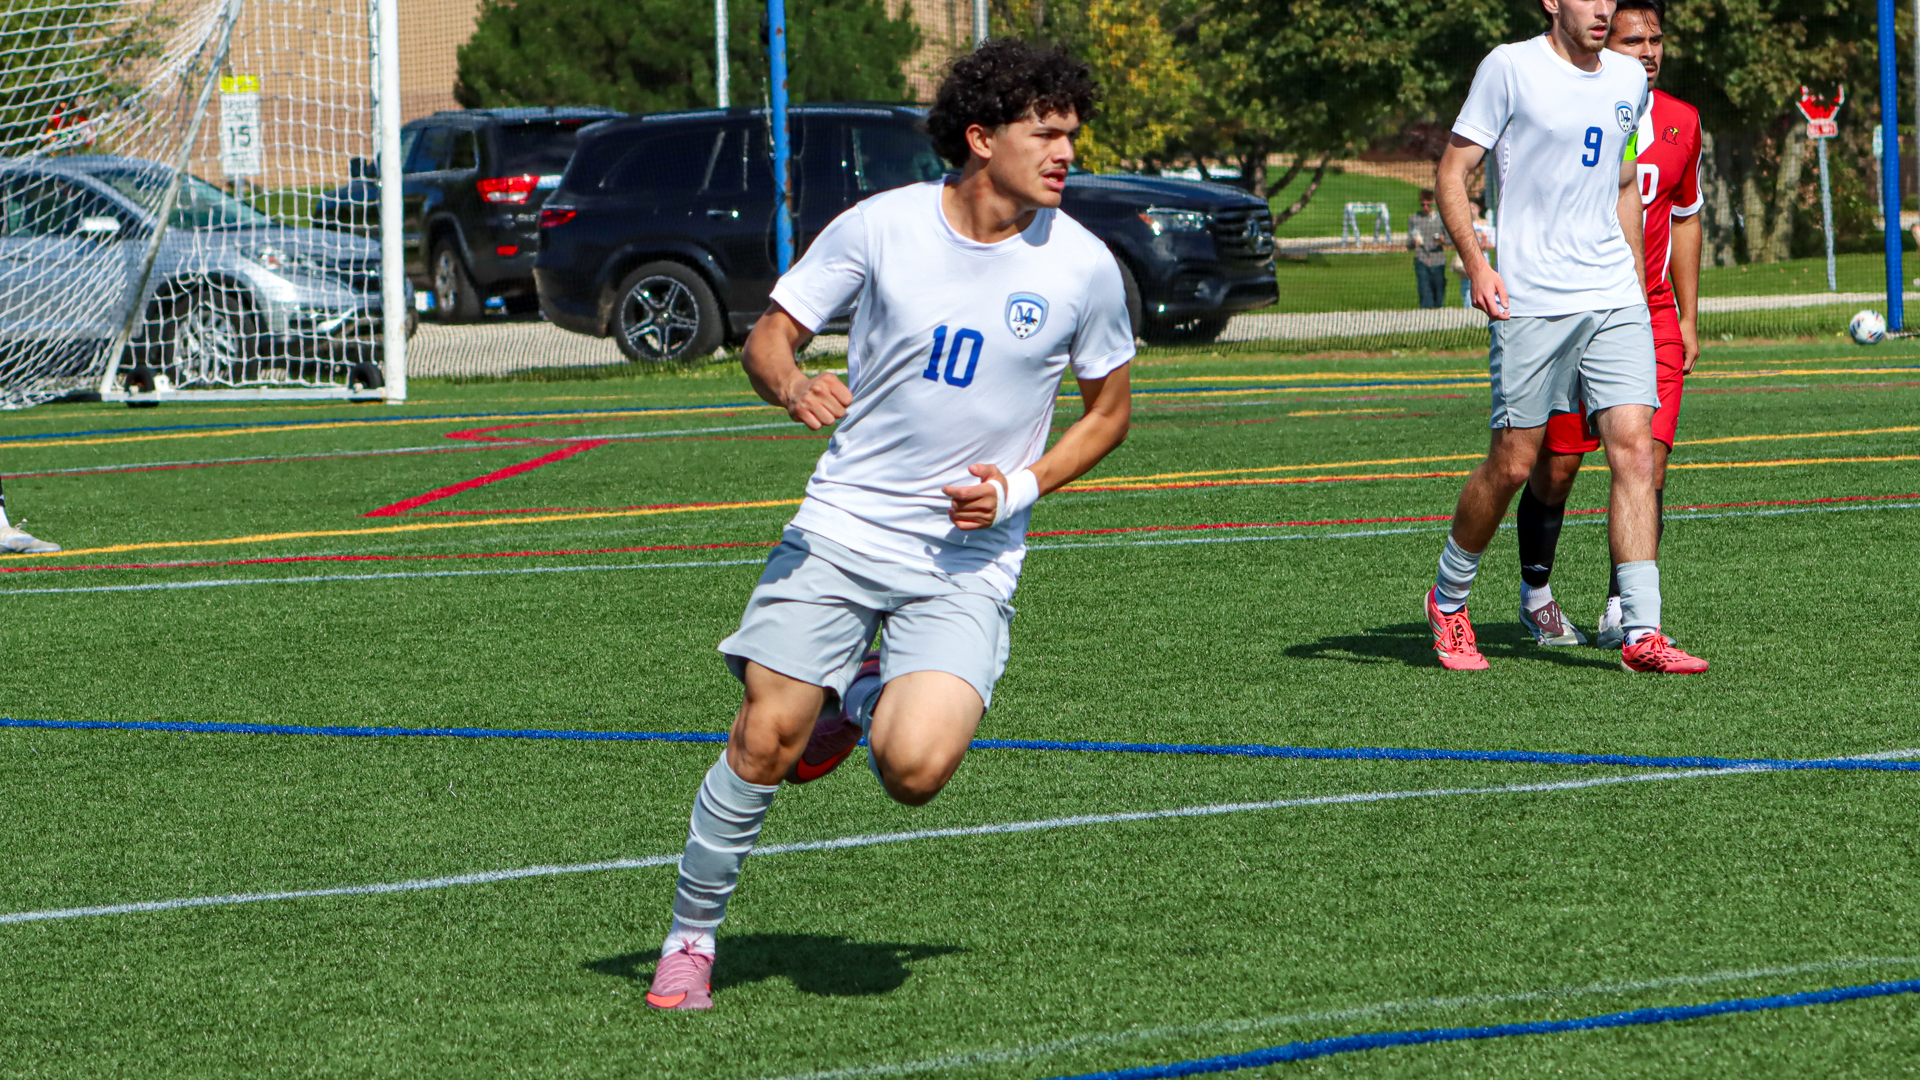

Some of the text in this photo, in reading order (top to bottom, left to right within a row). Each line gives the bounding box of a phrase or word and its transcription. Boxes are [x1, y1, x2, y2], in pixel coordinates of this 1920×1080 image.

[229, 125, 252, 147] 15
[1581, 126, 1603, 167] 9
[922, 324, 984, 388] 10
